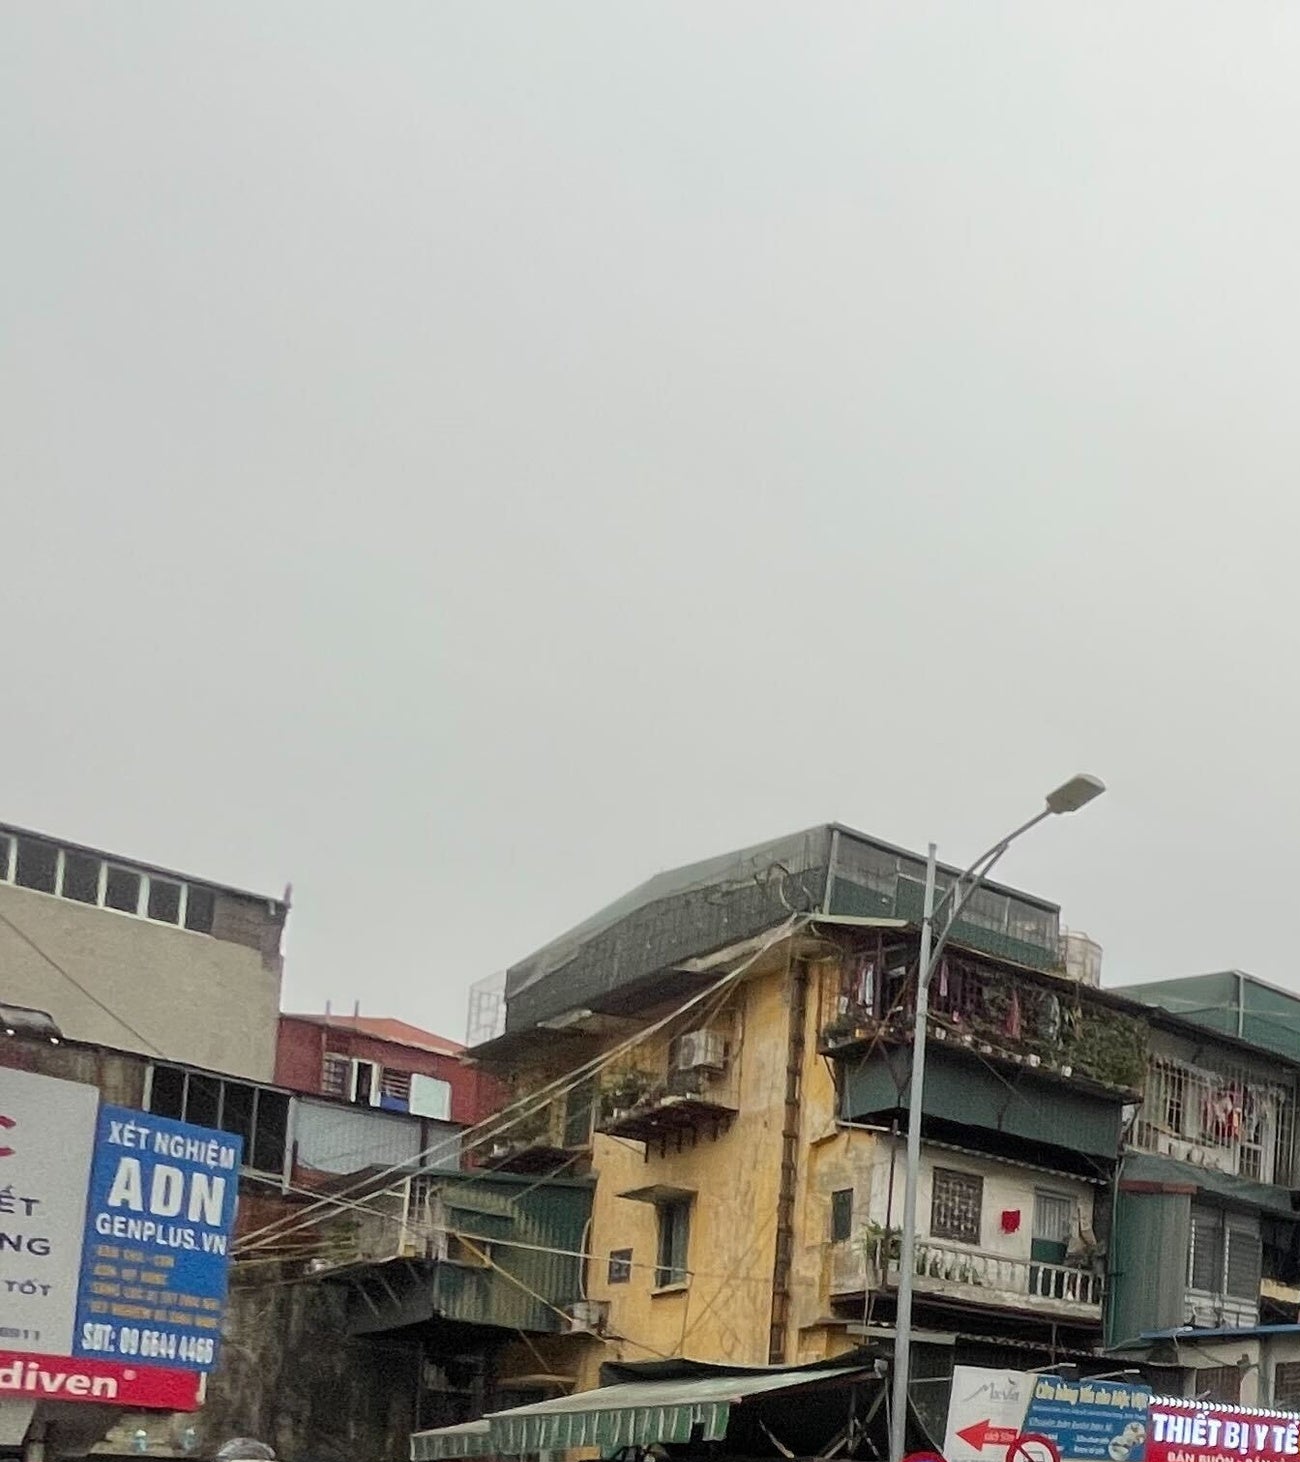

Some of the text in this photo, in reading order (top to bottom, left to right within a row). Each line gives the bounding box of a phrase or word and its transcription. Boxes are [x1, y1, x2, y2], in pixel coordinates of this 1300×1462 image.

[154, 1132, 235, 1170] NGHIỆM
[107, 1157, 226, 1227] ADN
[1152, 1410, 1222, 1447] THIẾT
[1224, 1421, 1249, 1455] BỊ
[1254, 1425, 1270, 1451] Y
[1271, 1419, 1300, 1455] TẾ
